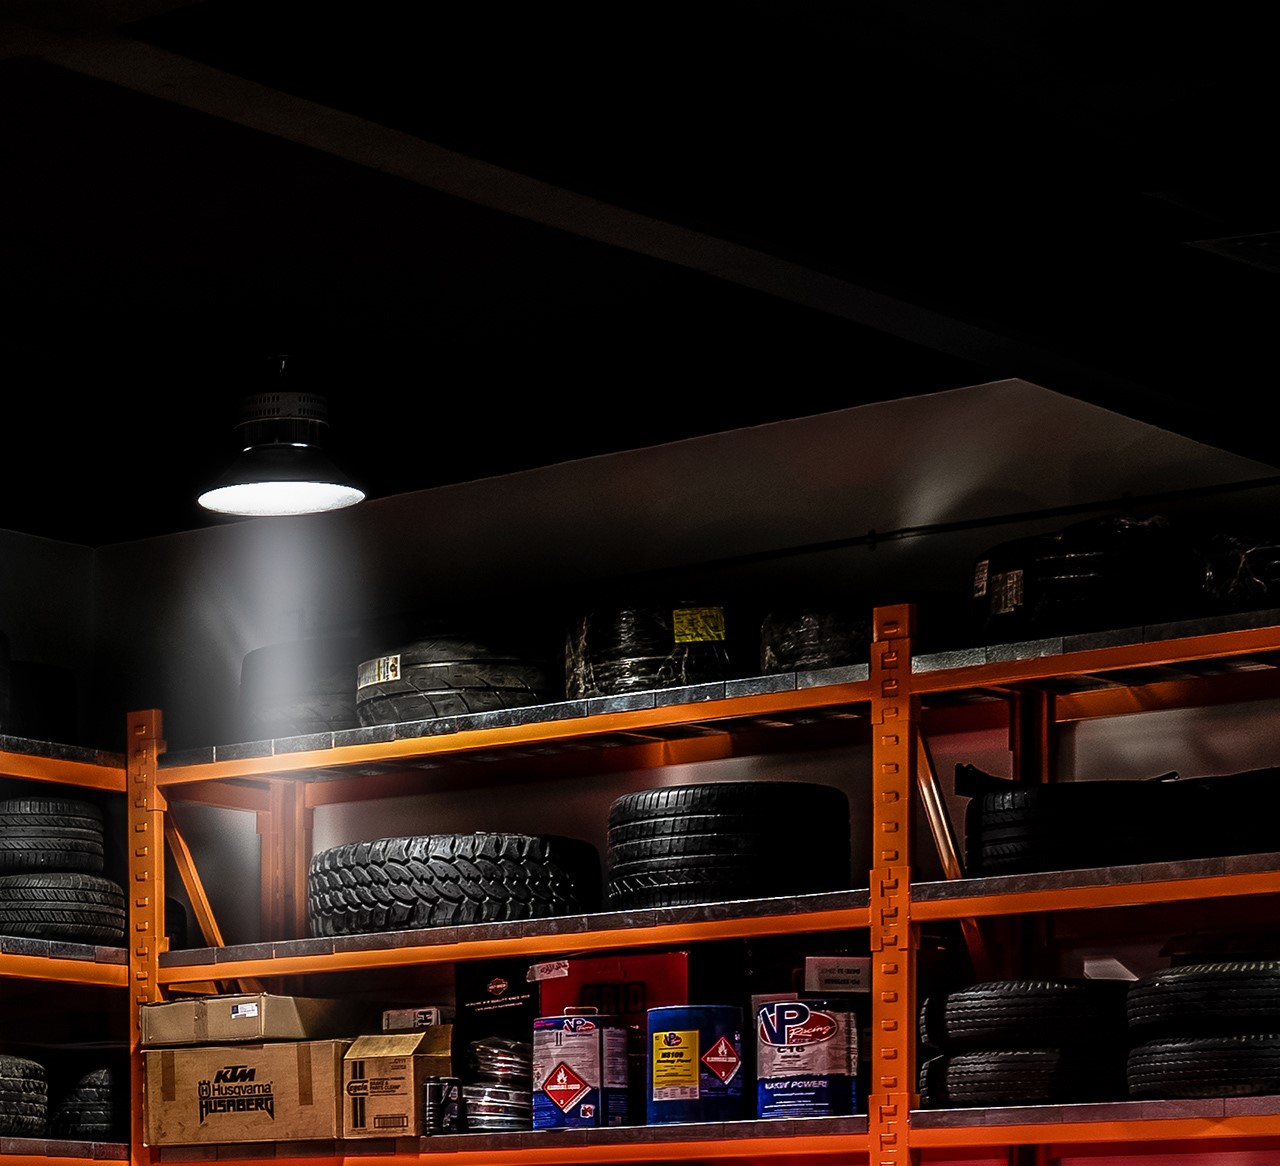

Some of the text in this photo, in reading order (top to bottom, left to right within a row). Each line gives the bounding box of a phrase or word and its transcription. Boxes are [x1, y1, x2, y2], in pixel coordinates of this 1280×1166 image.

[564, 1018, 586, 1032] VP
[760, 1002, 811, 1046] VP
[789, 1025, 835, 1038] Racing
[664, 1033, 677, 1047] VP
[214, 1065, 256, 1083] KTM
[212, 1081, 272, 1098] Husqvarna
[199, 1098, 275, 1125] HUSABERG
